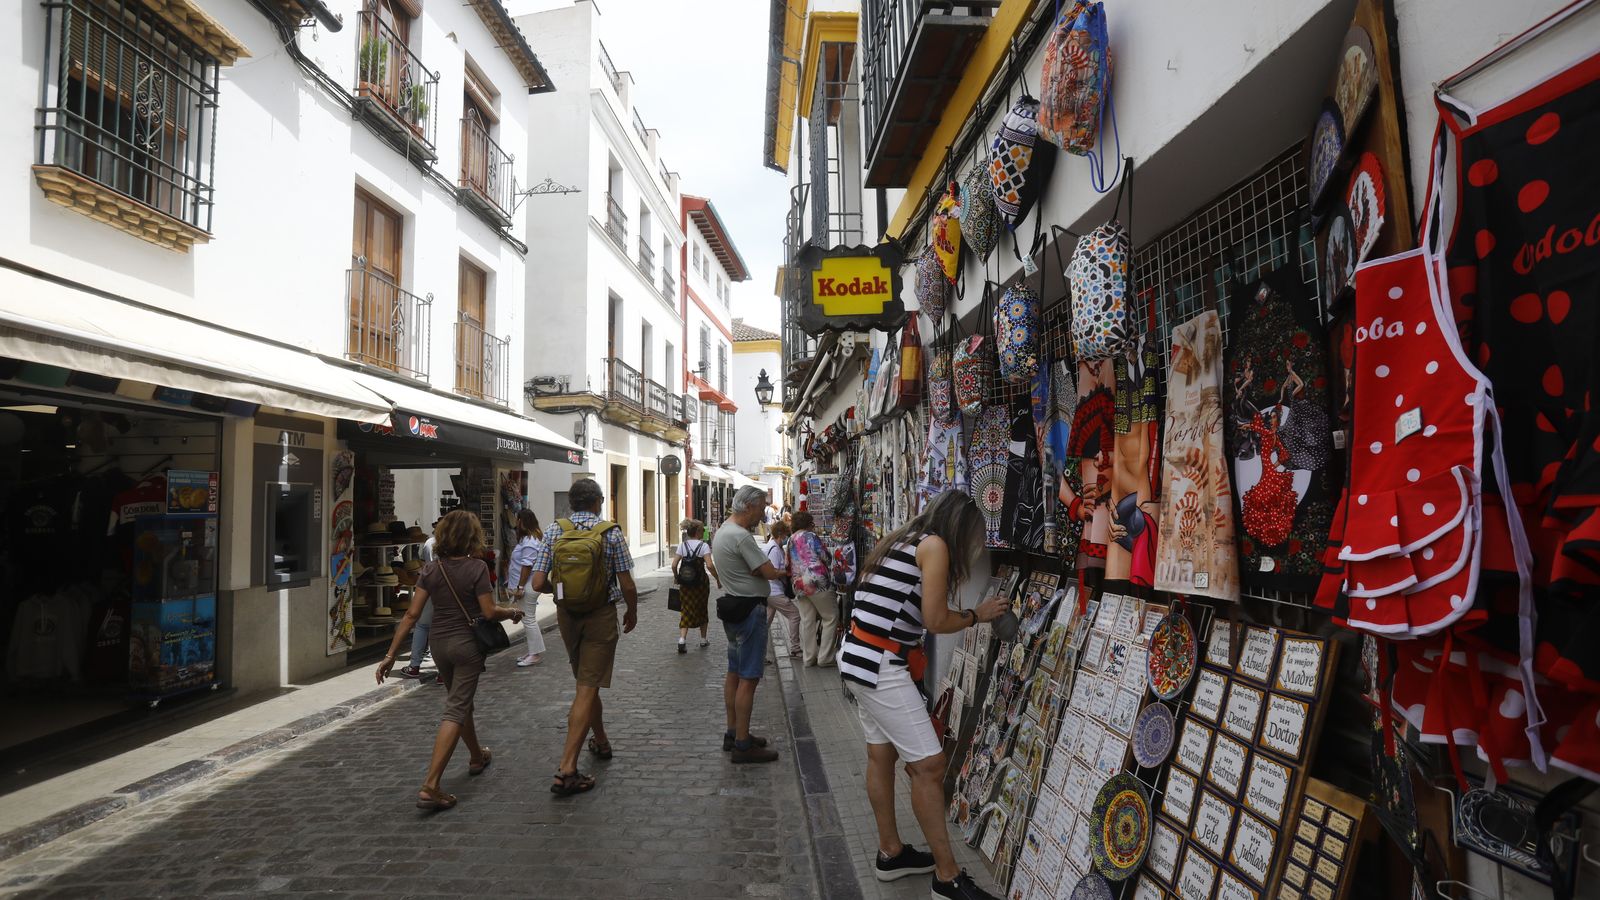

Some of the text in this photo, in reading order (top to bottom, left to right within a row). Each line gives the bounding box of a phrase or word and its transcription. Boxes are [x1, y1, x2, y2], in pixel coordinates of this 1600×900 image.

[818, 276, 888, 296] Kodak
[277, 431, 305, 446] ATM
[1242, 653, 1268, 672] Abuela
[1286, 656, 1314, 668] la mejor
[1284, 670, 1314, 687] Madre
[1238, 703, 1247, 712] un
[1228, 711, 1256, 731] Dentista
[1279, 716, 1290, 726] un
[1268, 721, 1299, 746] Doctor
[1261, 777, 1275, 788] una
[1249, 787, 1281, 811] Enfermera
[1206, 813, 1220, 824] una
[1199, 823, 1220, 846] Jefa
[1250, 835, 1261, 847] un
[1238, 843, 1268, 874] Jubilado
[1192, 871, 1205, 885] una
